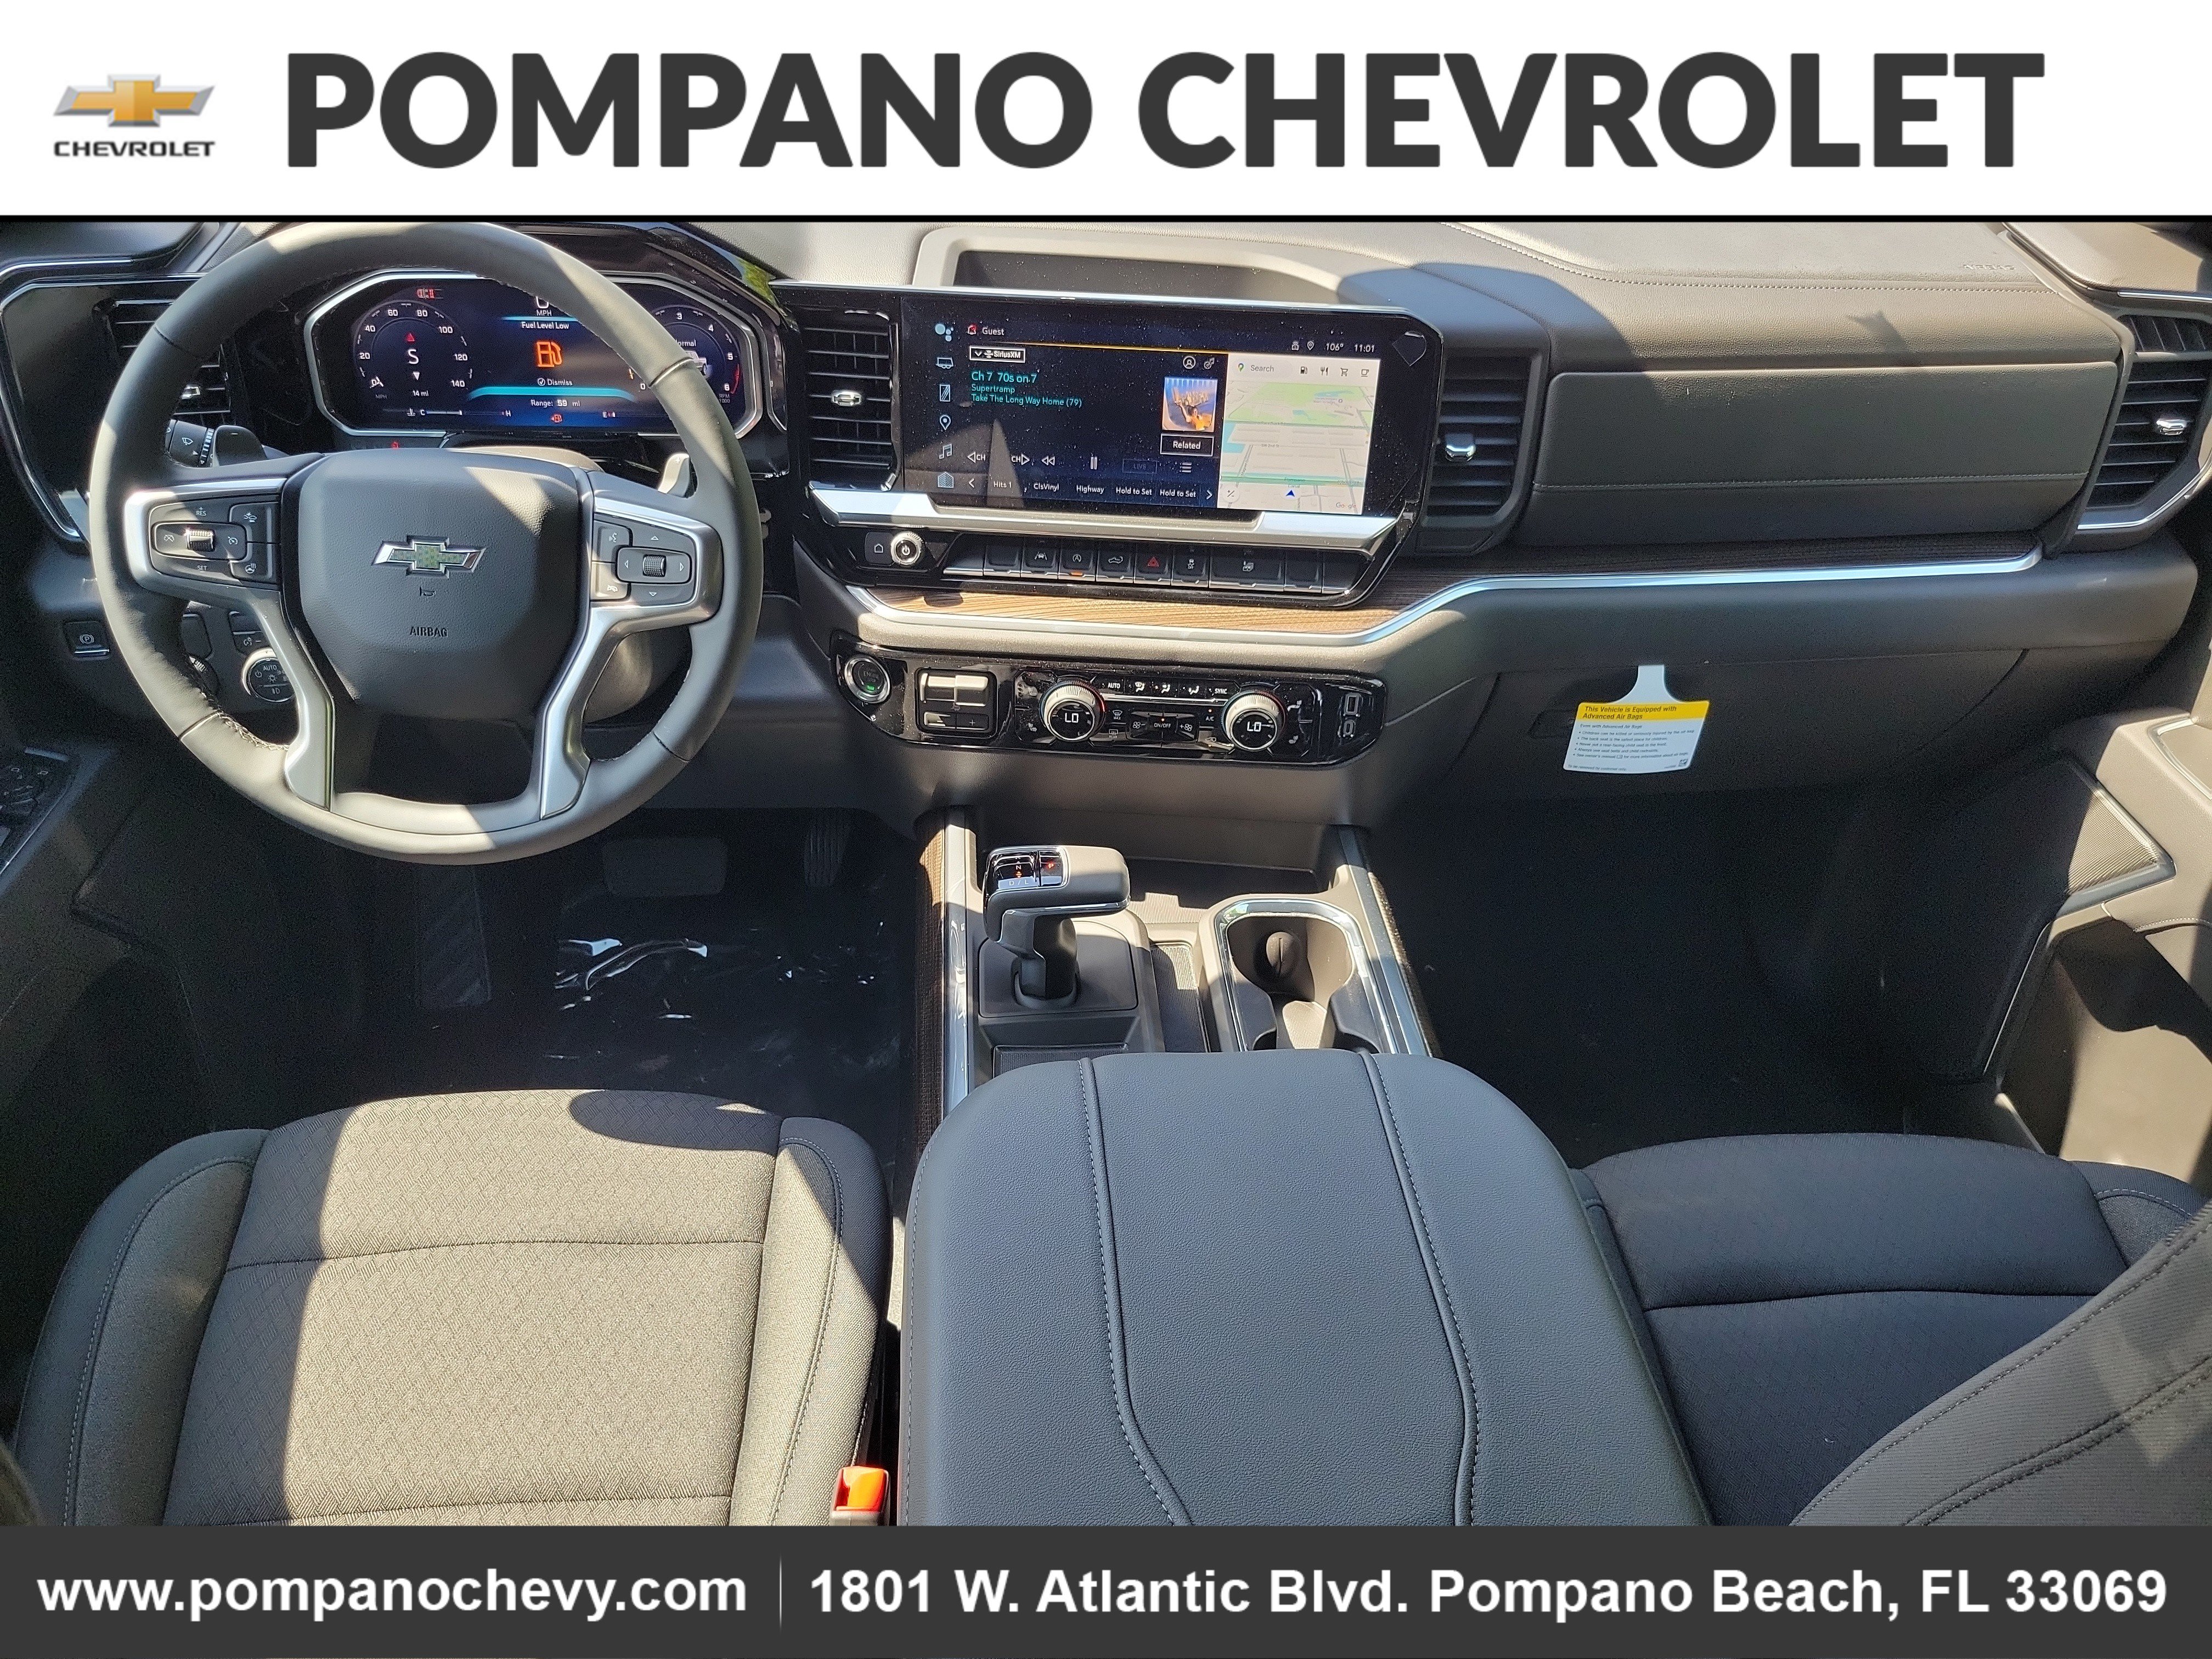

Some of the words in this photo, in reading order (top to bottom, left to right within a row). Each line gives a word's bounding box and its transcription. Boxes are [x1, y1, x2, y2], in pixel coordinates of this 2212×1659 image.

[982, 328, 1005, 336] Guest
[676, 338, 696, 347] ormal
[1354, 344, 1375, 353] 11:01
[408, 349, 419, 364] S
[994, 350, 1021, 359] SiriusXM
[972, 371, 985, 381] Ch
[987, 372, 992, 381] 7
[997, 373, 1014, 382] 70s
[1030, 374, 1037, 383] 7
[971, 385, 1015, 394] Supertramp
[531, 399, 554, 408] Range:
[971, 394, 988, 402] Take
[990, 394, 1003, 403] The
[1006, 395, 1024, 405] Long
[1025, 396, 1040, 406] Way
[1042, 397, 1064, 406] Home
[1066, 398, 1082, 408] (79)
[1173, 441, 1201, 450] Related
[1076, 484, 1104, 495] Highway
[1116, 486, 1131, 494] Hold
[410, 626, 448, 637] AIRBAG
[1065, 712, 1079, 723] LO
[1247, 721, 1262, 732] LO
